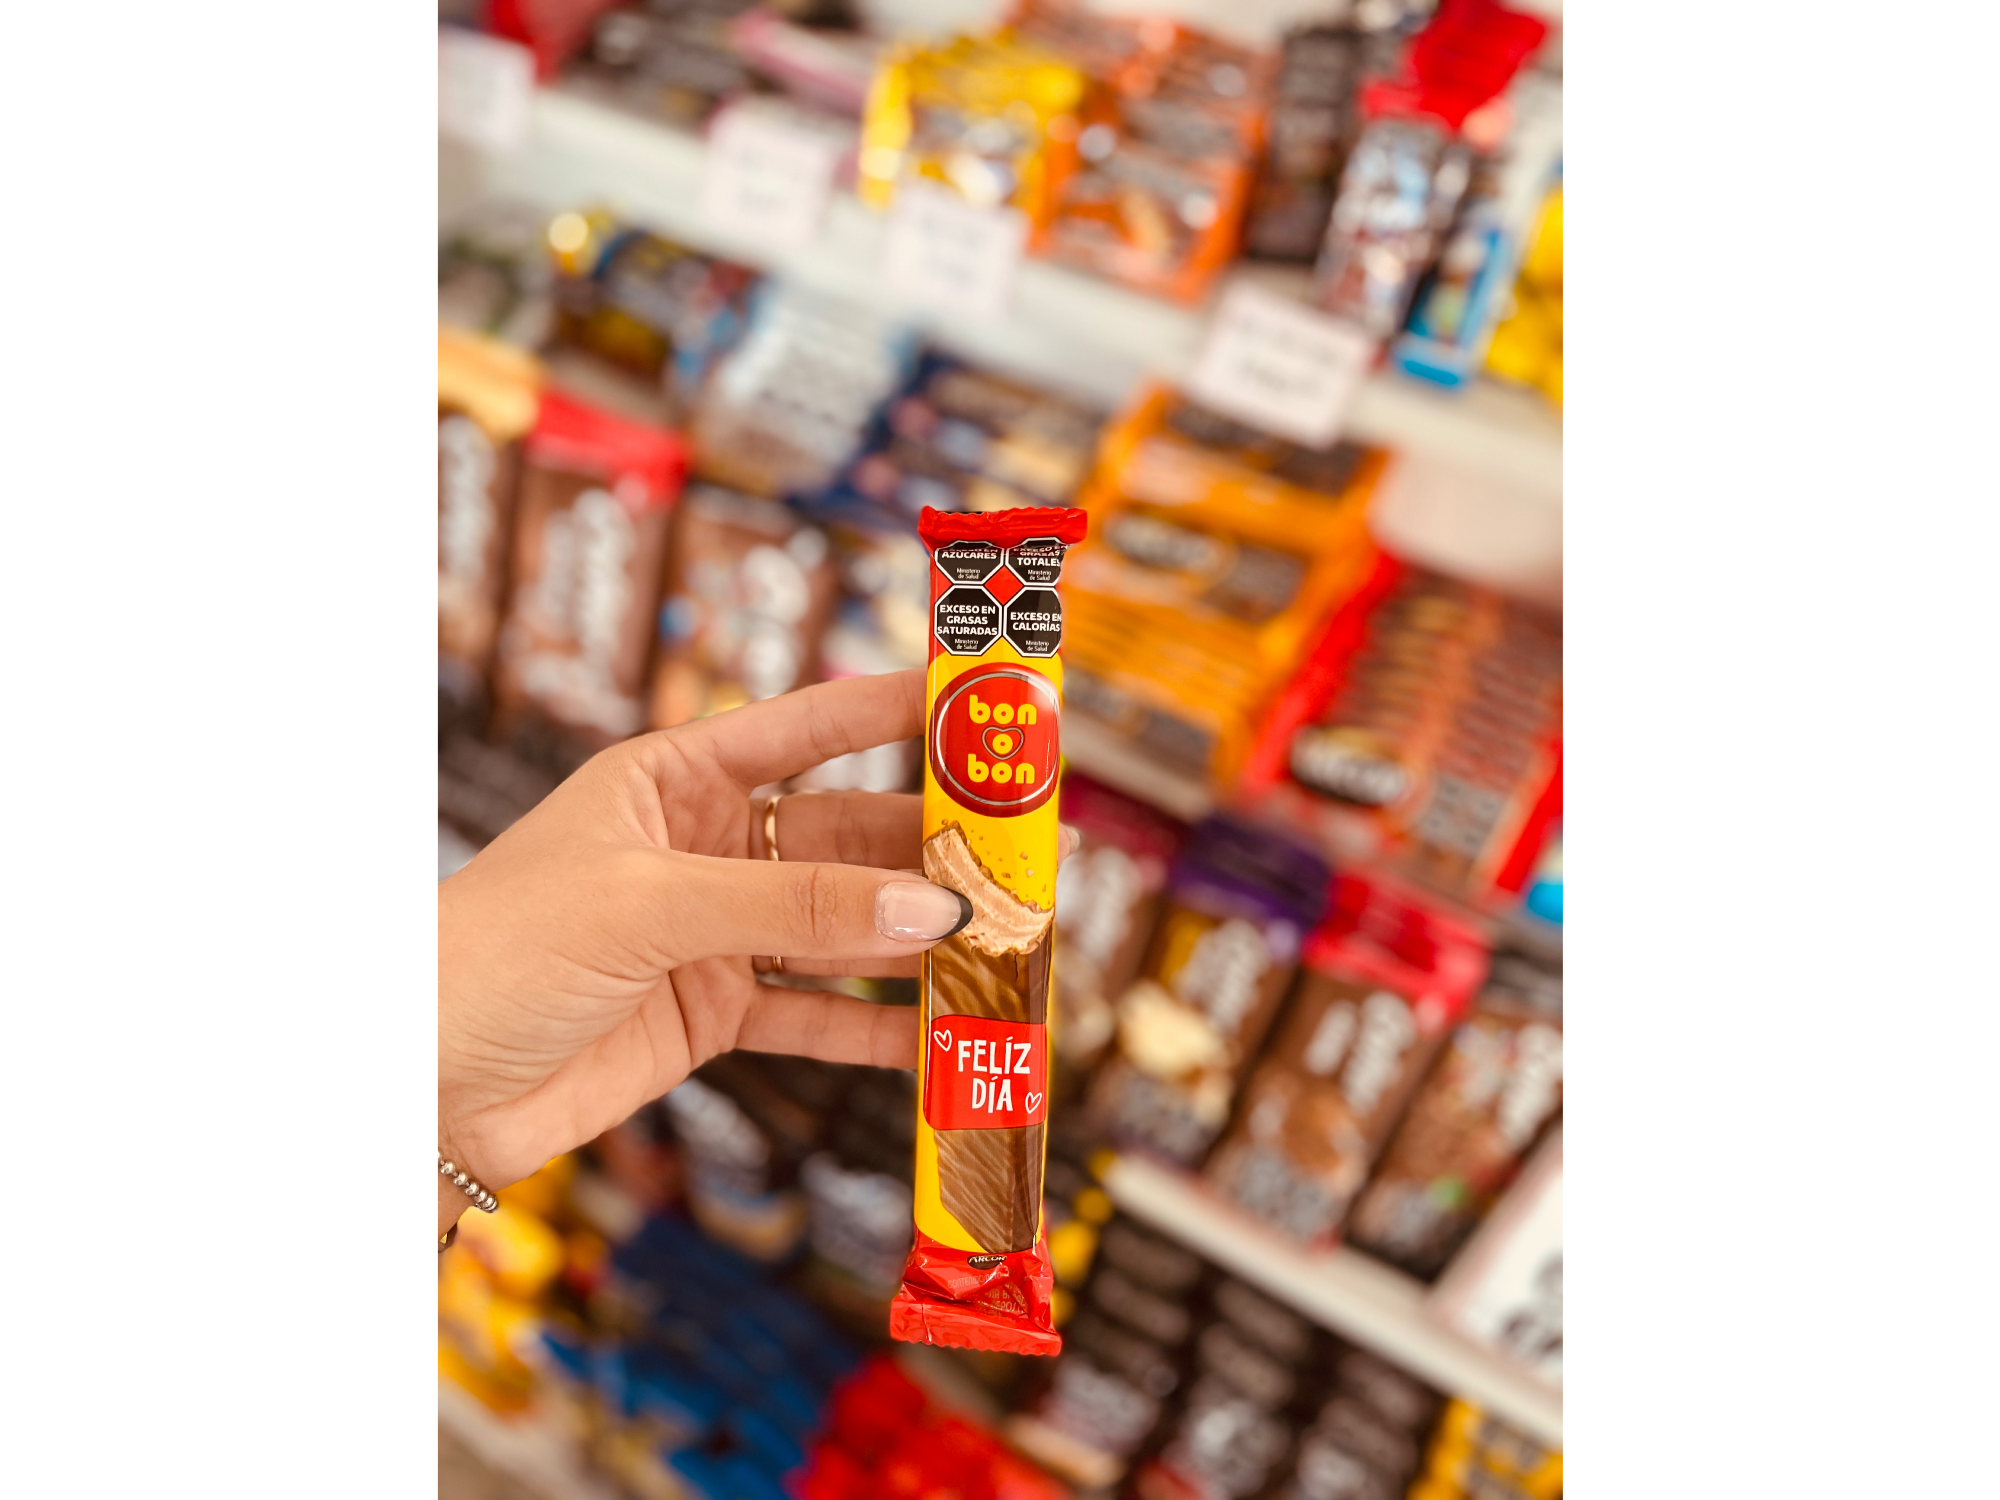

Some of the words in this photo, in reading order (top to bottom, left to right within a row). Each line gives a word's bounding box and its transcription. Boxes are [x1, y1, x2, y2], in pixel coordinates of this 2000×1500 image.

[939, 604, 979, 614] EXCESO
[981, 605, 996, 615] EN
[1010, 611, 1050, 622] EXCESO
[946, 615, 988, 625] GRASAS
[1012, 620, 1060, 632] CALORÍAS
[937, 626, 998, 636] SATURADAS
[968, 694, 1038, 726] bon
[992, 733, 1013, 755] o
[967, 753, 1036, 785] bon
[957, 1035, 1032, 1075] FELÍZ
[971, 1074, 1014, 1114] DÍA
